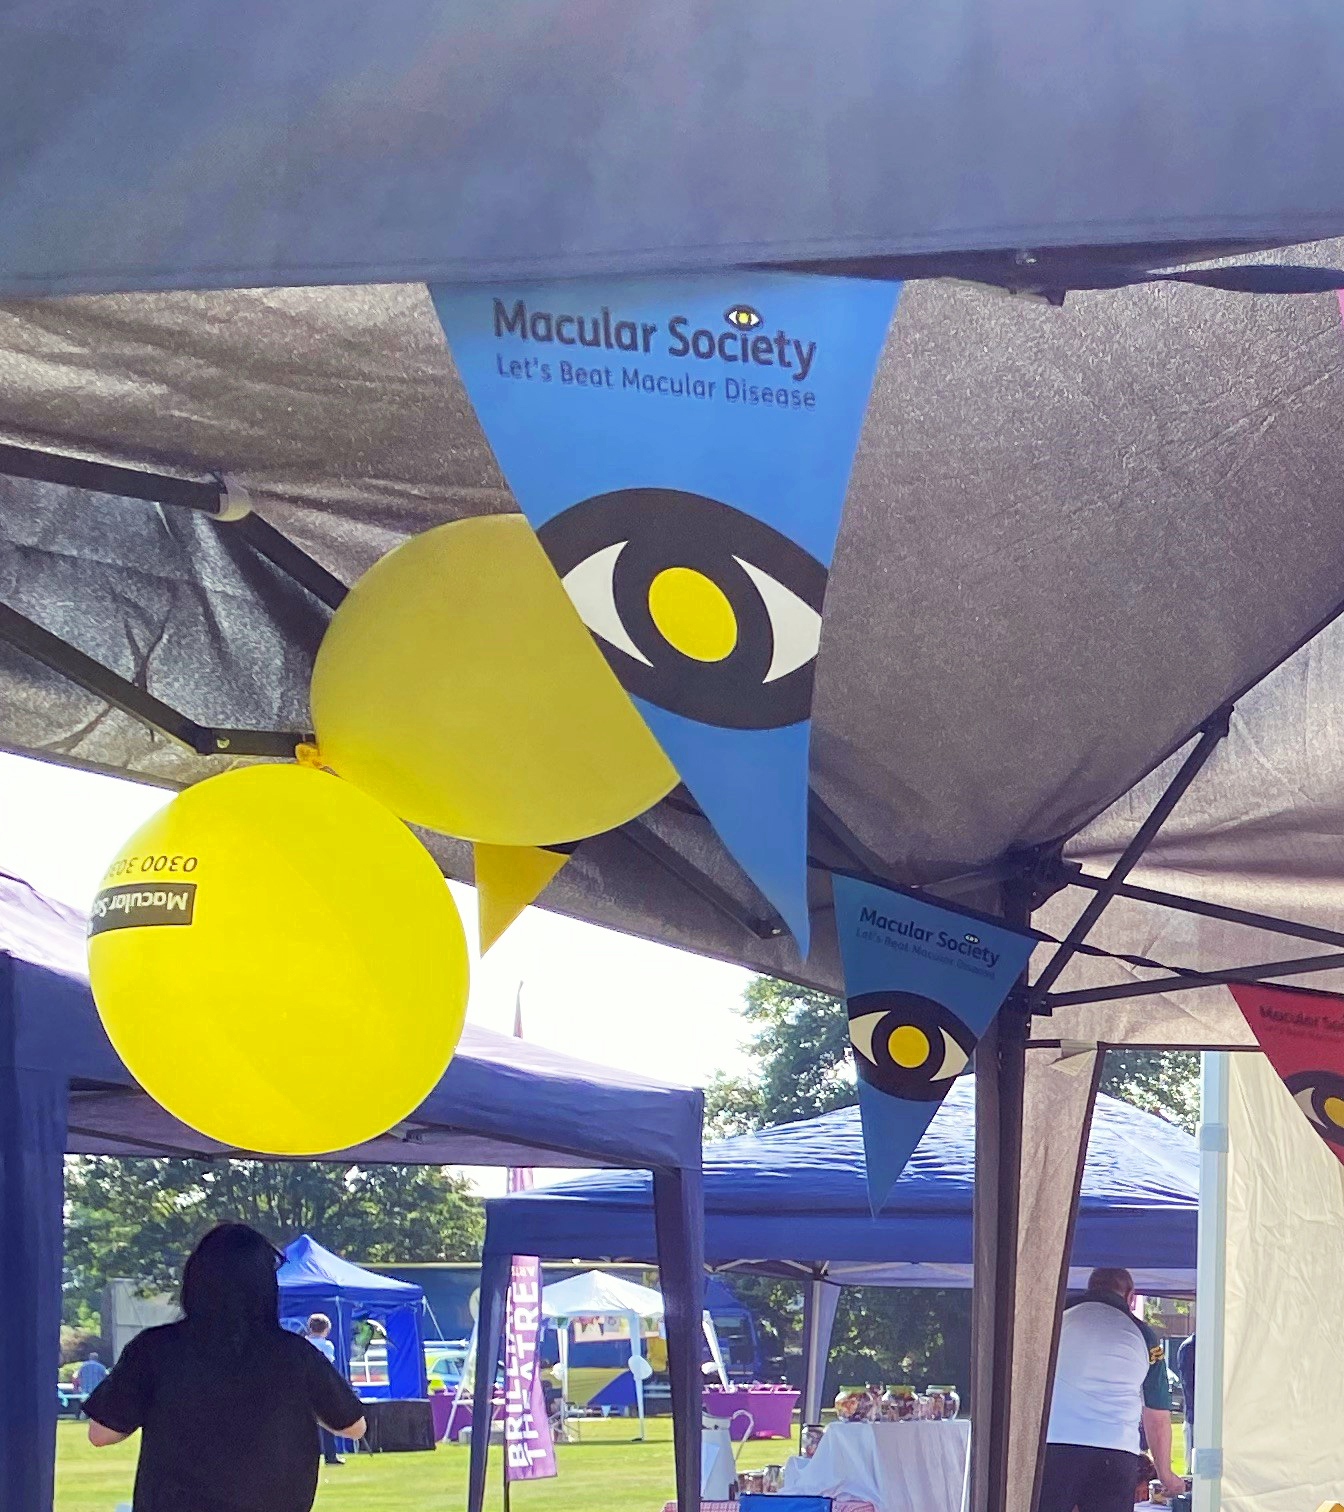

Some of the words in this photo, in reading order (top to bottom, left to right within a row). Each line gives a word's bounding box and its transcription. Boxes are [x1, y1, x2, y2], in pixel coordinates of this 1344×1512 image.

[492, 298, 657, 353] Macular
[668, 315, 817, 381] Society
[496, 353, 552, 383] Let's
[560, 360, 613, 388] Beat
[622, 367, 717, 399] Macular
[725, 378, 816, 410] Disease
[141, 855, 198, 872] 0300
[110, 891, 189, 914] Macular
[860, 906, 934, 942] Macular
[936, 931, 1000, 968] Society
